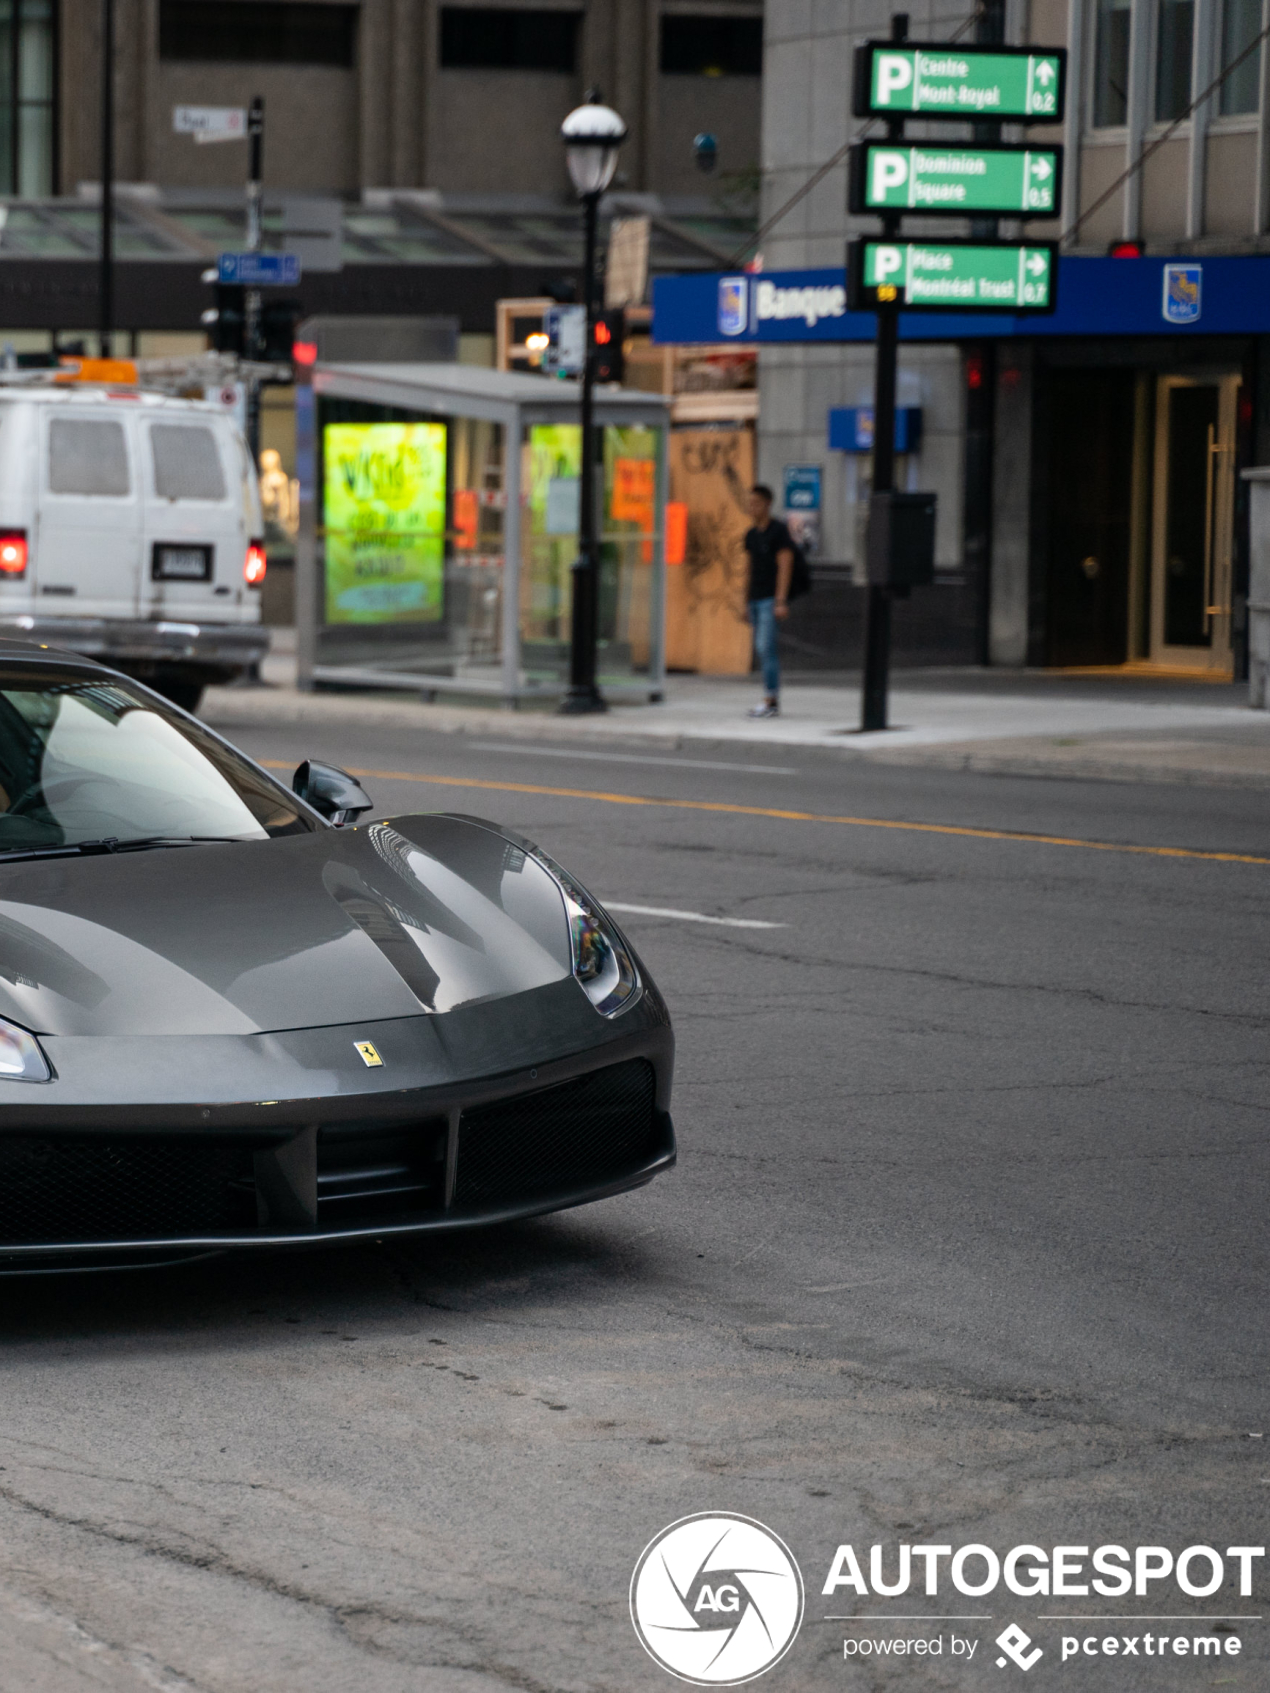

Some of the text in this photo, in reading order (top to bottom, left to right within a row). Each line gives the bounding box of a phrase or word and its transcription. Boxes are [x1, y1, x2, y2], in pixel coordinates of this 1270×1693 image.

[876, 54, 912, 105] P
[919, 57, 970, 77] Centre
[919, 84, 1000, 110] Mont-Royal
[872, 152, 908, 202] P
[916, 154, 986, 175] Dominion
[914, 181, 966, 205] Square
[874, 246, 902, 282] P
[913, 249, 953, 270] Place
[911, 276, 1016, 298] Montréal Trust
[756, 280, 847, 328] Banque
